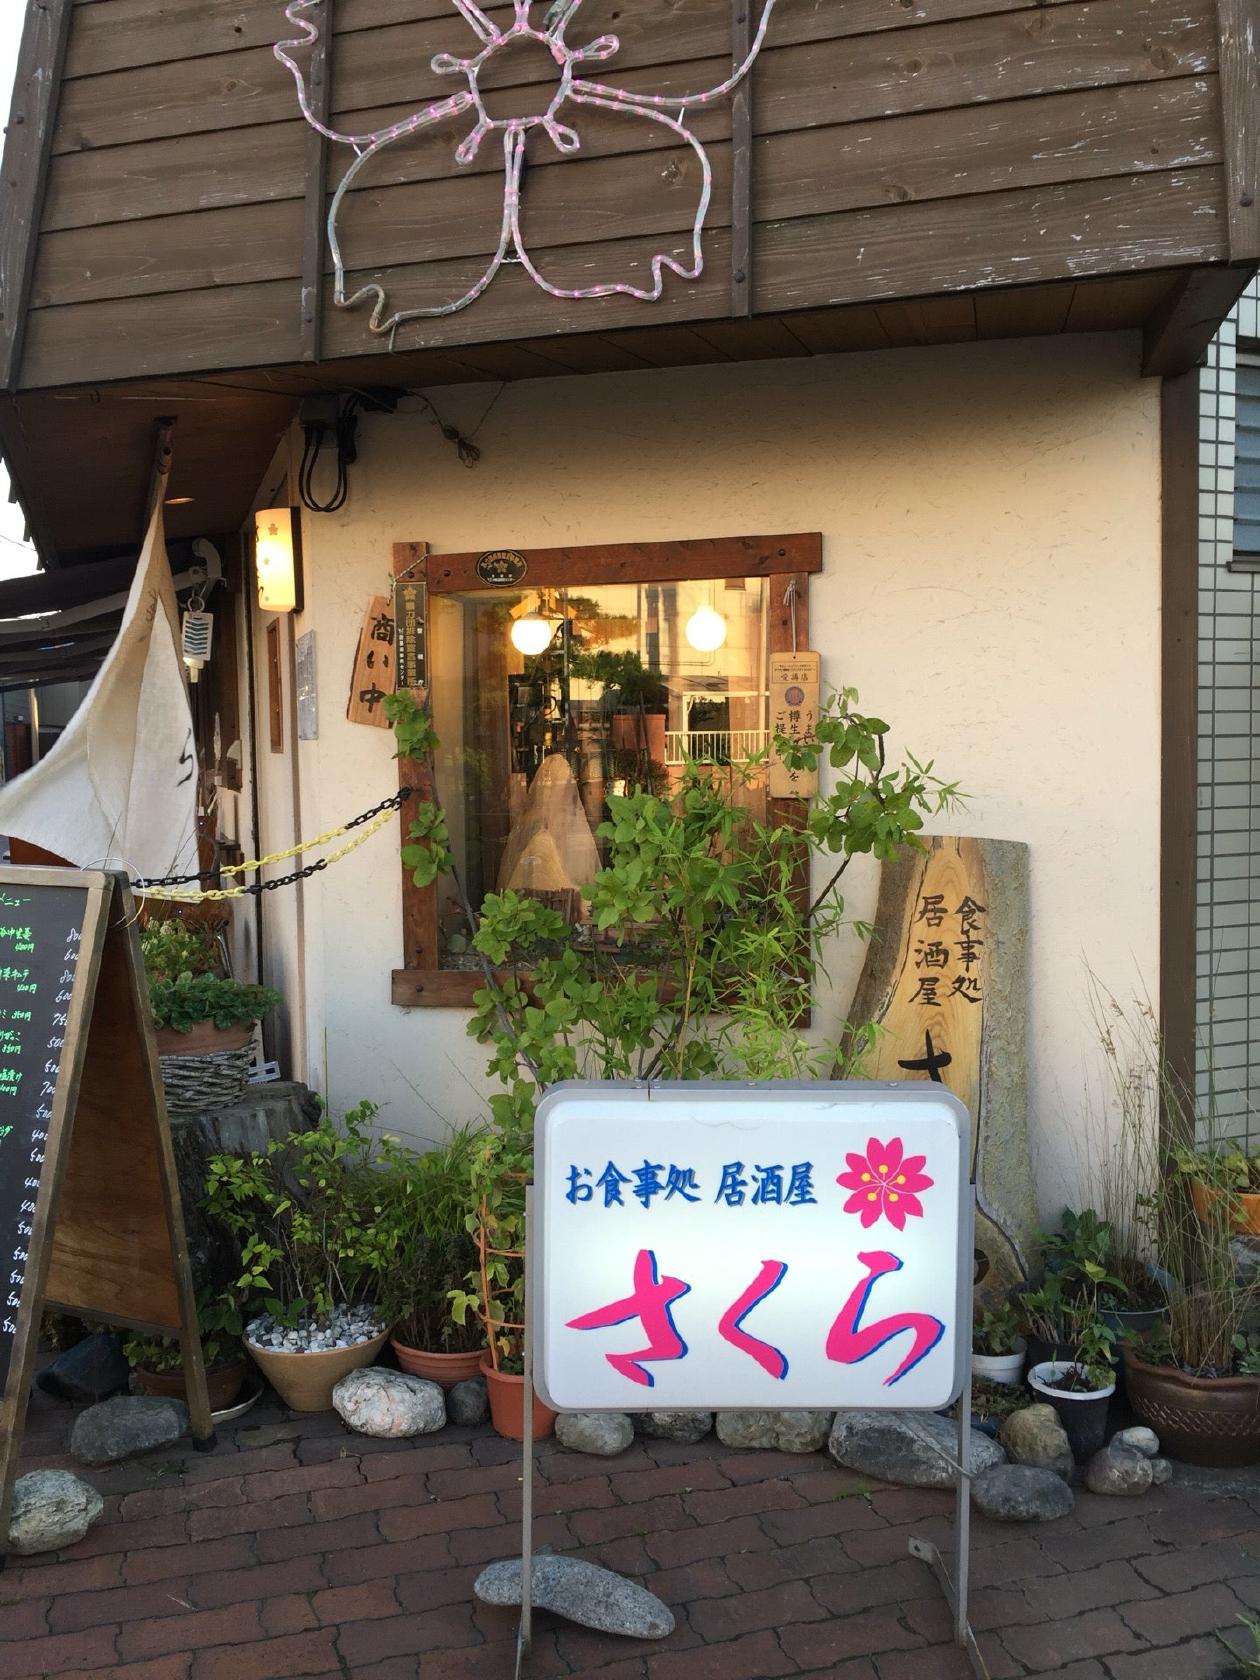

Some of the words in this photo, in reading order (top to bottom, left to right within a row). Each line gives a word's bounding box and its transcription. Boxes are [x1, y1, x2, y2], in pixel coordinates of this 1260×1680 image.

[359, 613, 395, 713] 商い中
[908, 893, 951, 1007] 居酒屋
[947, 895, 987, 1004] 食事処
[565, 1158, 702, 1209] お食事処
[714, 1160, 819, 1208] 居酒屋
[564, 1248, 946, 1388] さくら
